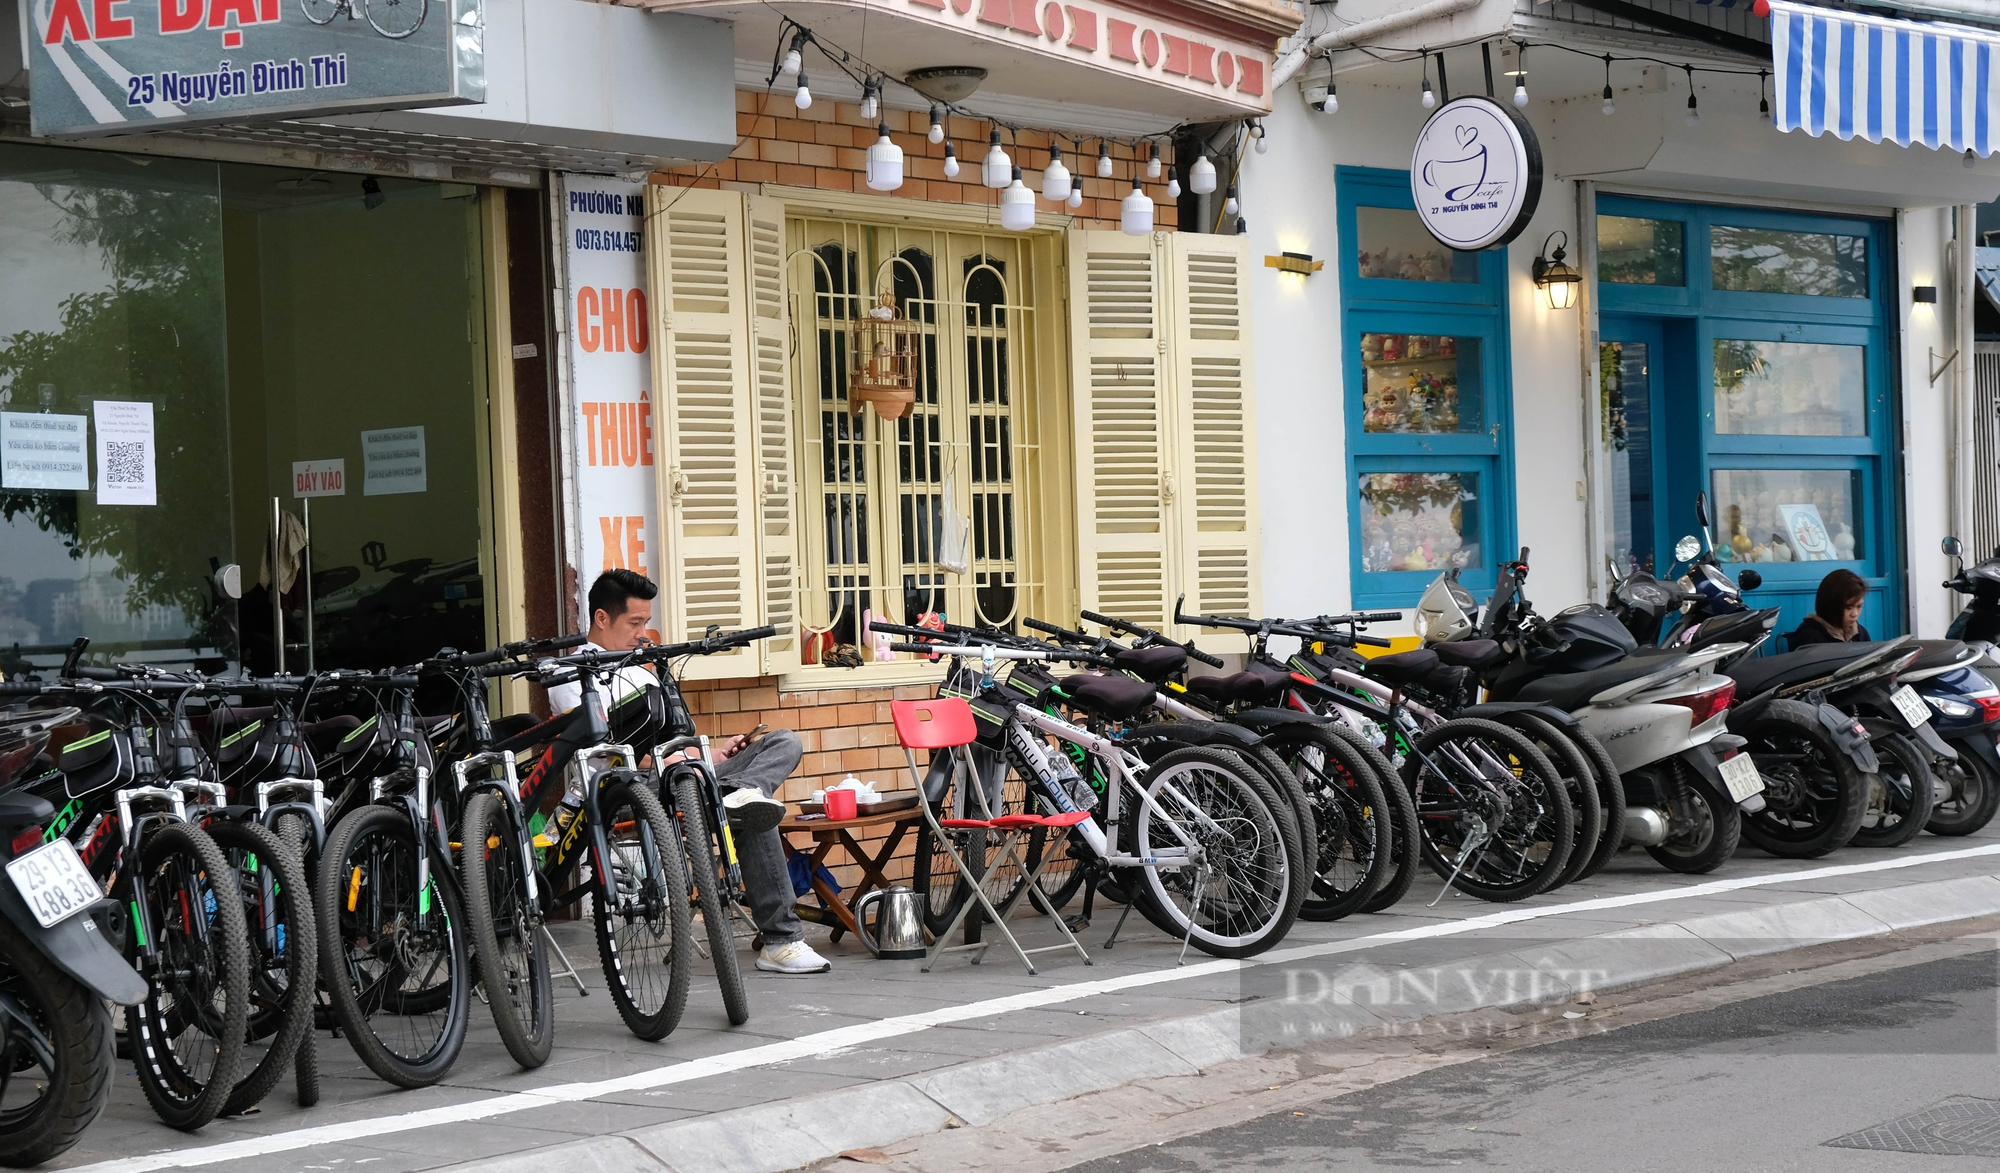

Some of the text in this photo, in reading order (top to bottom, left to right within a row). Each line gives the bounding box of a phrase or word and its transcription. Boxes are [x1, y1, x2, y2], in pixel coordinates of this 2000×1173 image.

[128, 54, 346, 105] 25 Nguyễn Đình Thi
[569, 190, 623, 216] PHƯƠNG
[1488, 201, 1498, 209] THI
[575, 228, 642, 253] 0973.614.457
[577, 285, 648, 355] CHO
[582, 390, 654, 468] THUÊ
[297, 464, 342, 492] ĐẨY VÀO
[599, 516, 647, 578] XE
[33, 873, 94, 920] 488.36
